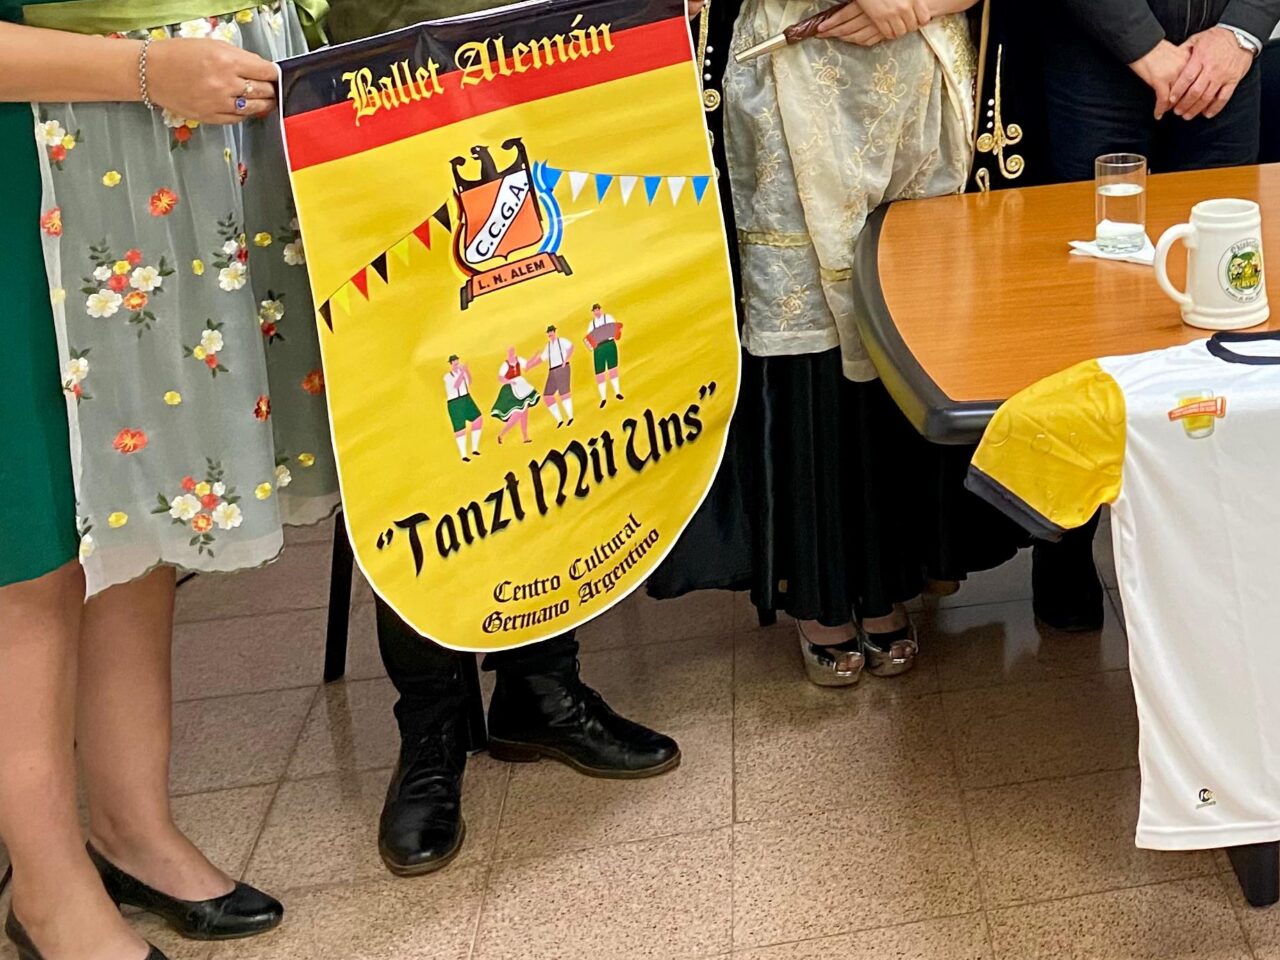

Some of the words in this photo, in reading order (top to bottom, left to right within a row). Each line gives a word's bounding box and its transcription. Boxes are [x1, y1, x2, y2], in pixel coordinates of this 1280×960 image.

[342, 58, 444, 126] Ballet
[454, 14, 617, 90] Alemán
[475, 182, 528, 257] C.C.G.A.
[478, 280, 490, 290] L.
[493, 273, 508, 285] N.
[511, 259, 546, 279] ALEM
[528, 430, 618, 516] Mit
[482, 599, 570, 633] Germano
[578, 528, 660, 606] Argentino
[493, 574, 561, 603] Centro
[568, 512, 642, 581] Cultural
